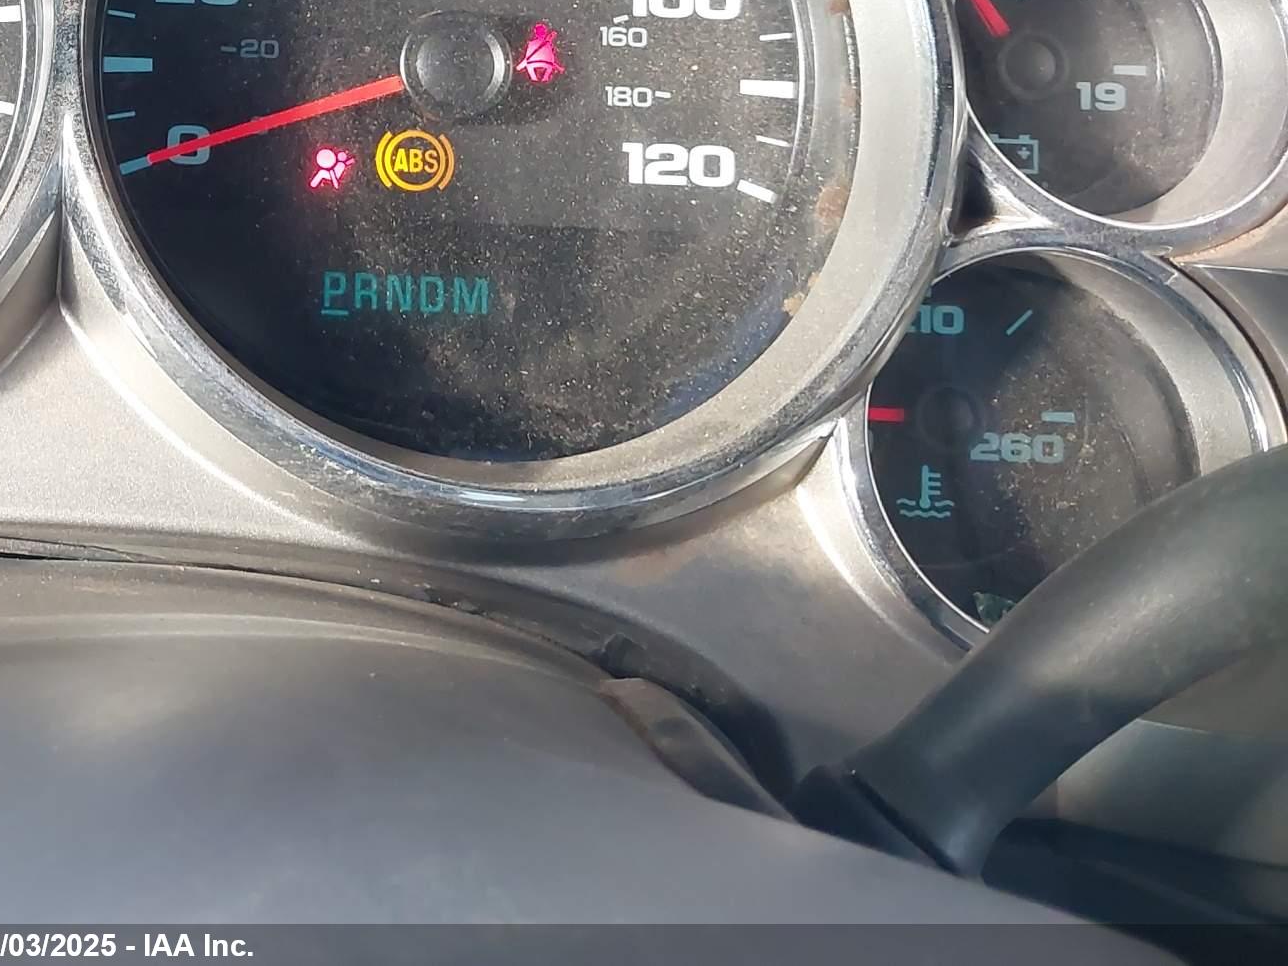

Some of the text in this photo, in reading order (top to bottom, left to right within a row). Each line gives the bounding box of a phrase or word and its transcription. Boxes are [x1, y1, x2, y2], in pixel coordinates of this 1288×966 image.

[240, 39, 279, 59] 20
[599, 25, 649, 47] 160
[605, 85, 653, 108] 180
[1075, 81, 1128, 111] 19
[166, 124, 212, 165] 0
[393, 156, 439, 174] ABS
[621, 142, 736, 188] 120
[905, 303, 966, 335] 10
[969, 432, 1065, 464] 260
